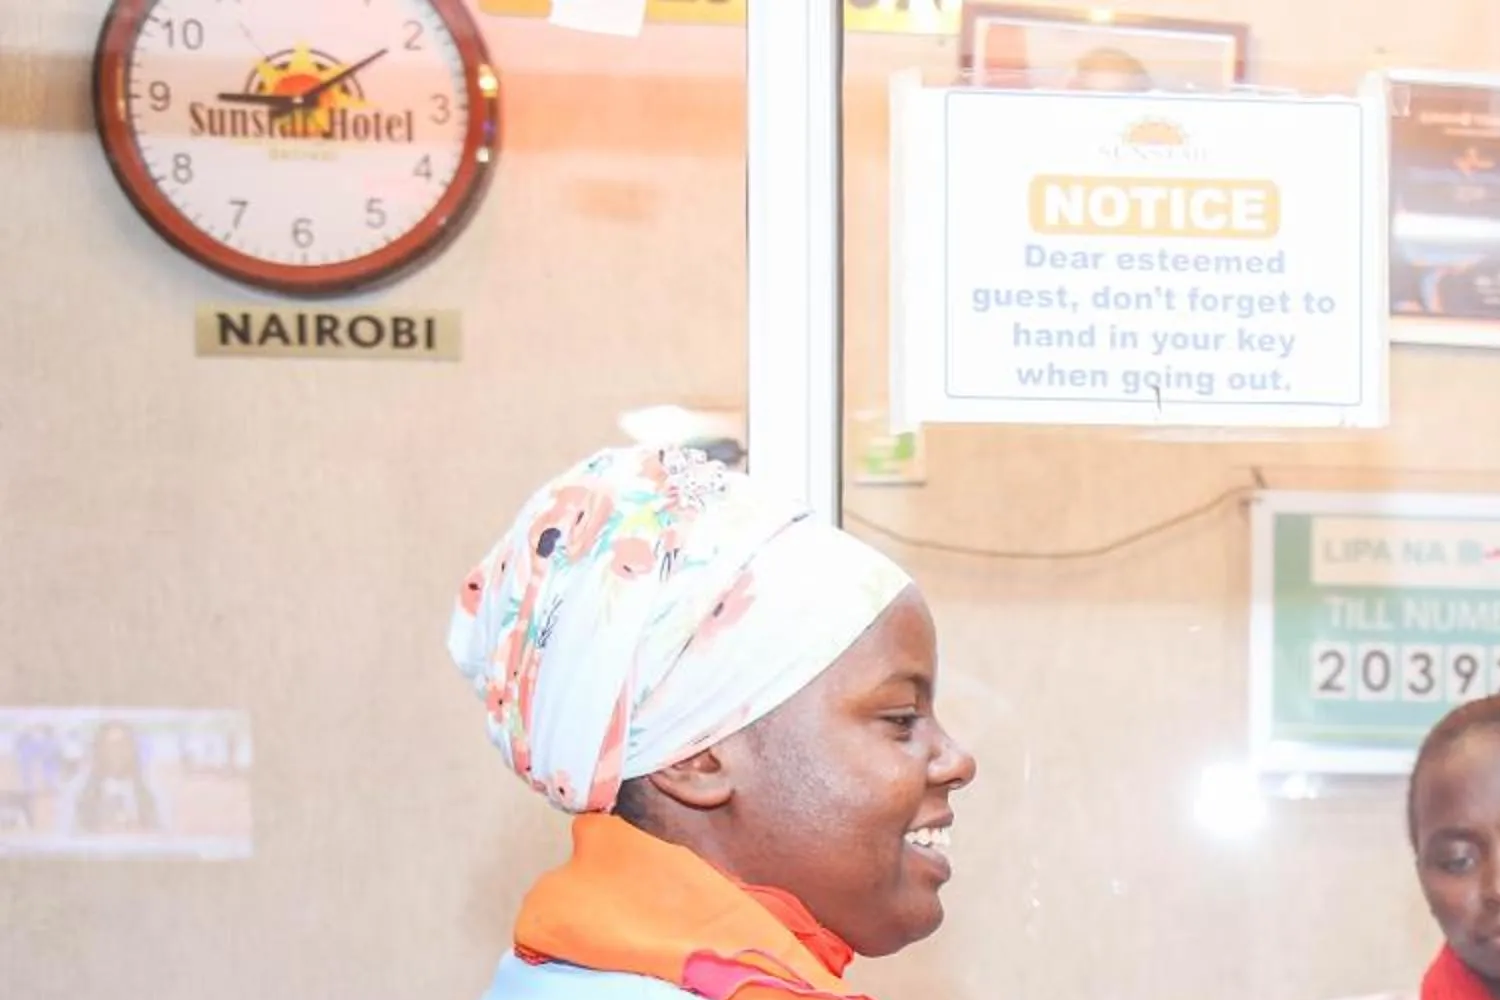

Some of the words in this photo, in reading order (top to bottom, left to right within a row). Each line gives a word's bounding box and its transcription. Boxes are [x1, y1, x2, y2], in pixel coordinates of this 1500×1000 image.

[163, 18, 205, 51] 10
[402, 20, 424, 51] 2
[148, 80, 171, 112] 9
[429, 93, 451, 124] 3
[324, 107, 415, 143] Hotel
[171, 152, 193, 184] 8
[413, 153, 433, 181] 4
[228, 200, 249, 229] 7
[365, 198, 387, 228] 5
[1044, 184, 1267, 231] NOTICE
[291, 218, 314, 248] 6
[1024, 244, 1105, 269] Dear
[1116, 249, 1286, 275] esteemed
[972, 285, 1079, 314] guest,
[1091, 285, 1176, 312] don't
[1187, 287, 1292, 319] forget
[1303, 290, 1336, 314] to
[216, 312, 437, 350] NAIROBI
[1012, 322, 1096, 348] hand
[1109, 324, 1138, 349] in
[1151, 331, 1226, 355] your
[1237, 328, 1296, 358] key
[1016, 362, 1109, 388] when
[1121, 365, 1215, 395] going
[1227, 368, 1291, 391] out.
[1323, 539, 1391, 565] LIPA
[1324, 596, 1394, 631] TILL
